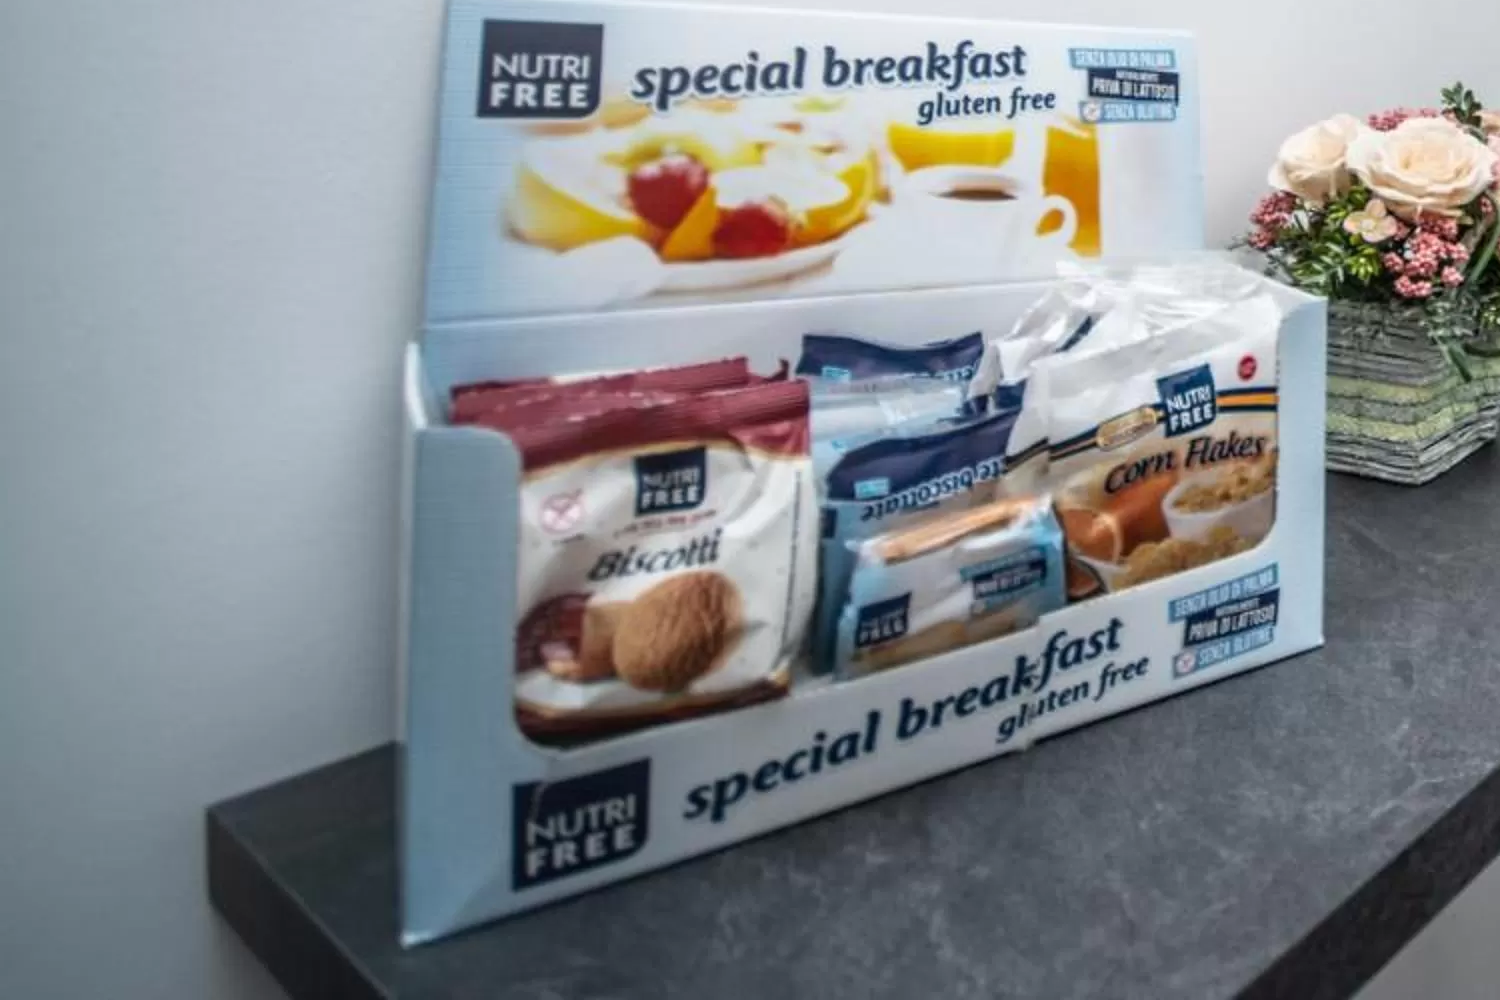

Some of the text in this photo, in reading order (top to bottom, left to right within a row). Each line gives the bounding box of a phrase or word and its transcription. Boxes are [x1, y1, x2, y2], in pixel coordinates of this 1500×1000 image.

[491, 52, 592, 79] NUTRI
[631, 40, 1027, 112] special breakfast
[489, 81, 590, 108] FREE
[917, 86, 1056, 126] gluten free
[1166, 385, 1212, 413] NUTRI
[1169, 403, 1213, 432] FREE
[641, 467, 699, 488] NUTRI
[1104, 430, 1268, 494] Corn Flakes
[640, 484, 699, 509] FREE
[586, 527, 723, 582] Biscotti
[682, 615, 1124, 823] special breakfast
[996, 656, 1150, 744] gluten free
[526, 793, 637, 846] NUTRI
[526, 823, 636, 878] FREE
